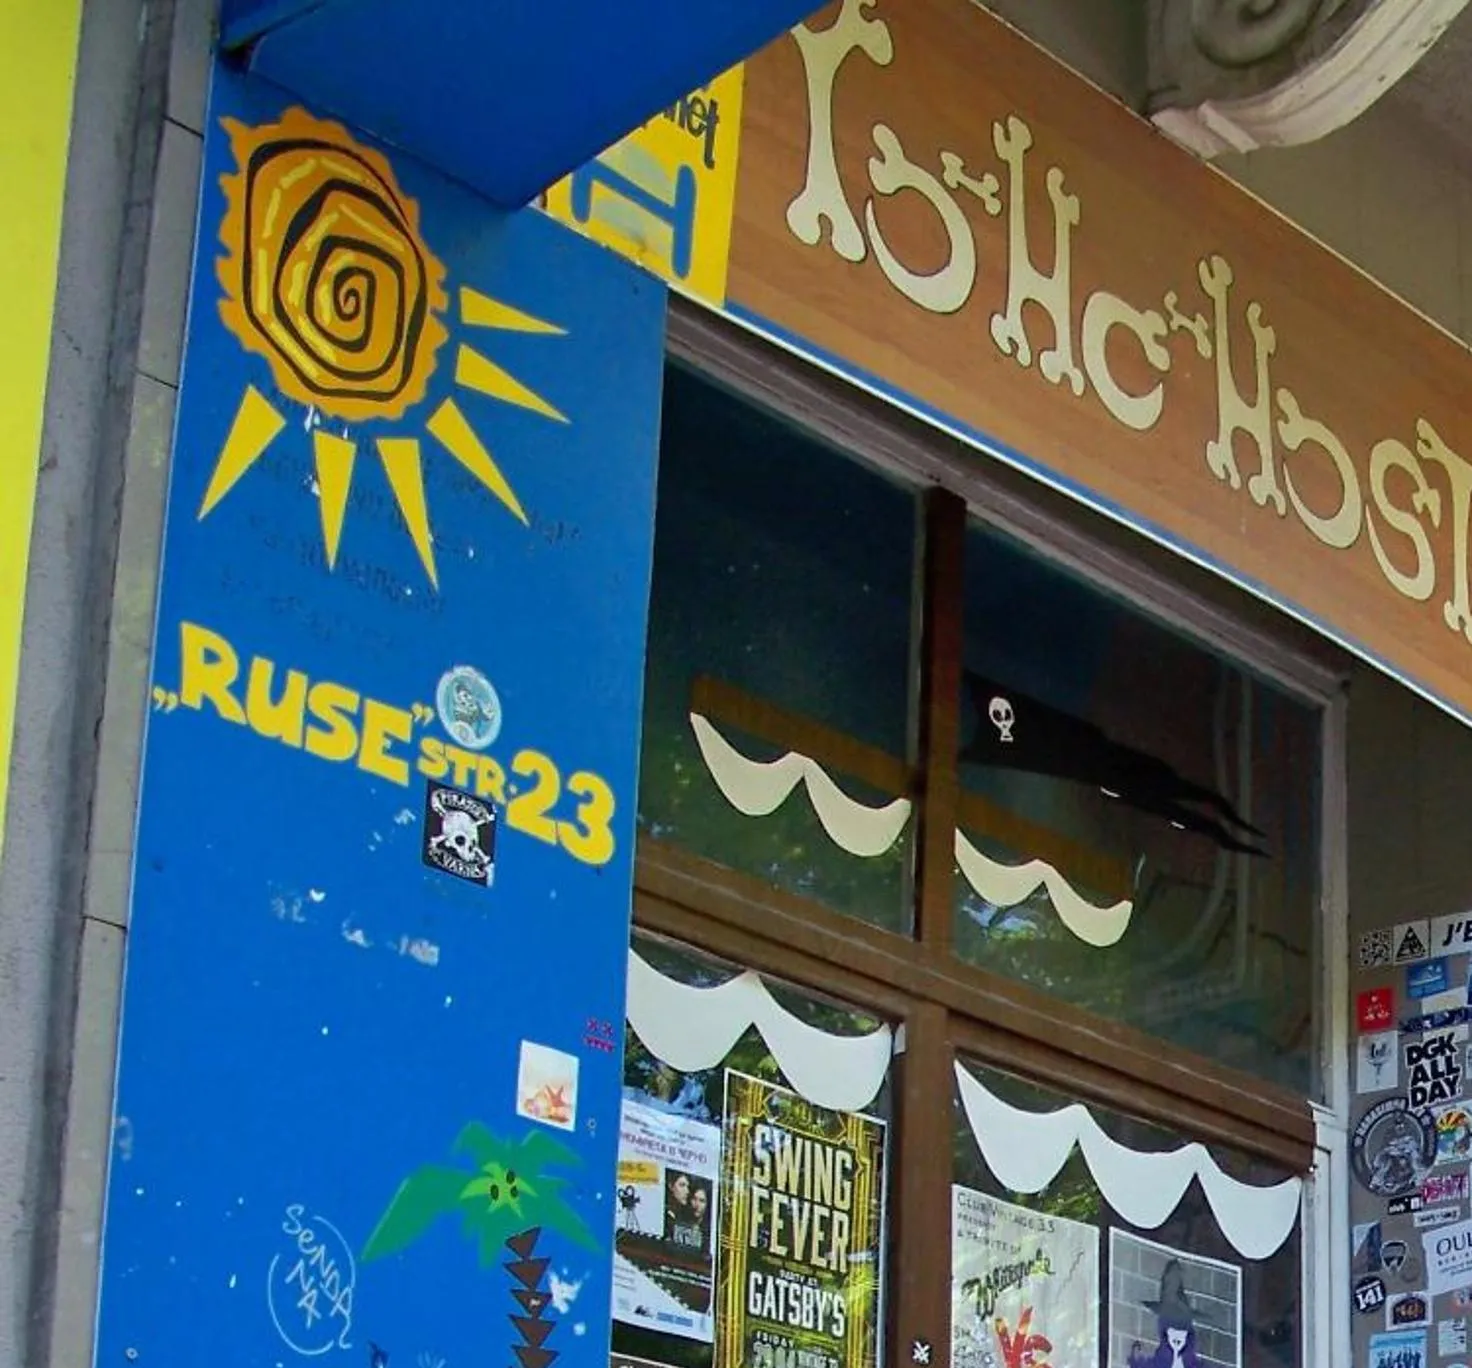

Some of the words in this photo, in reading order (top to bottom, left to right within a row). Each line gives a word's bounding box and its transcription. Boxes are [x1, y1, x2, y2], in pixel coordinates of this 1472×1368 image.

[507, 749, 616, 865] 23
[1407, 1032, 1458, 1066] DGK
[1410, 1056, 1461, 1086] ALL
[752, 1123, 852, 1211] SWING
[750, 1185, 850, 1274] FEVER
[749, 1270, 847, 1338] GATSBY'S
